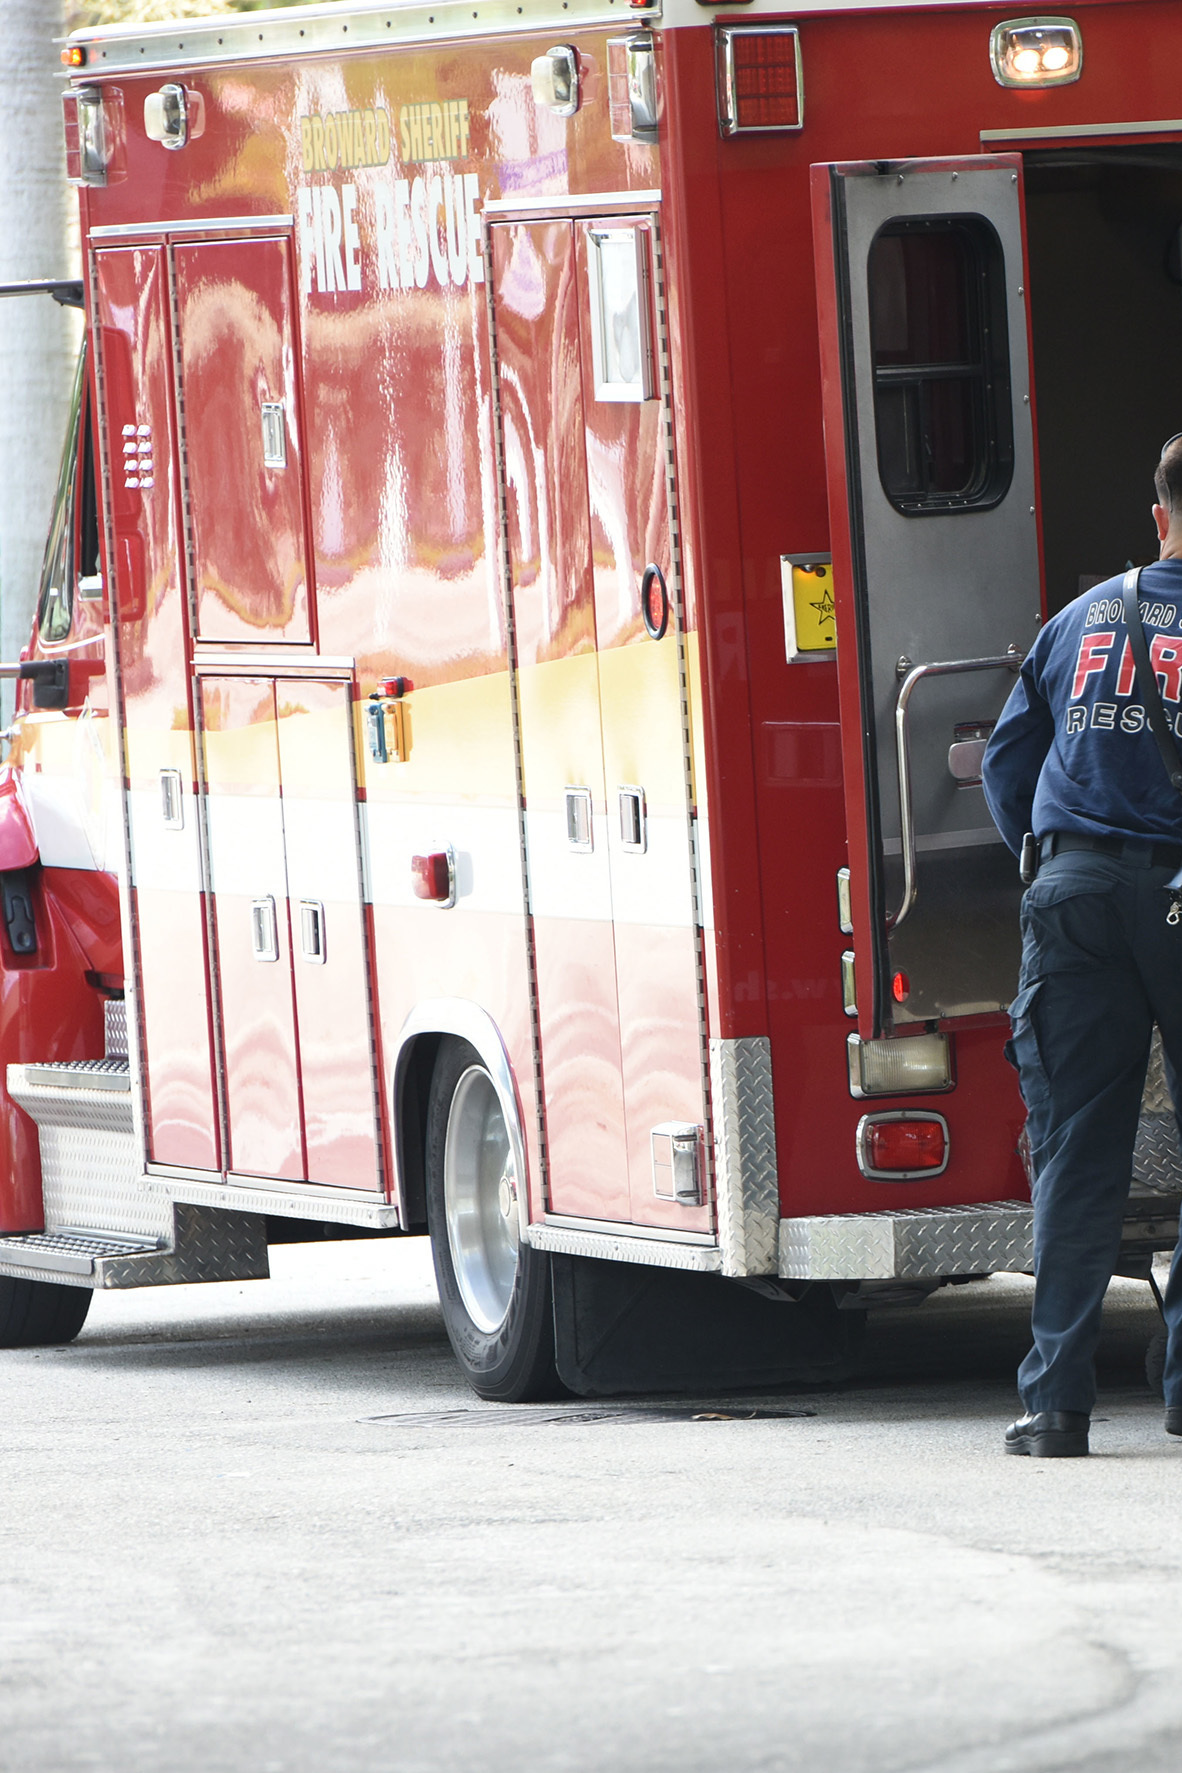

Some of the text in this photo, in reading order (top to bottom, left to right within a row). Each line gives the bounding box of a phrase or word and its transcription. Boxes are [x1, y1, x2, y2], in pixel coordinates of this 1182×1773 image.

[300, 98, 470, 174] BROWARD SHERIFF
[297, 173, 485, 293] FIRE RESCUE
[1085, 598, 1177, 628] BROARD
